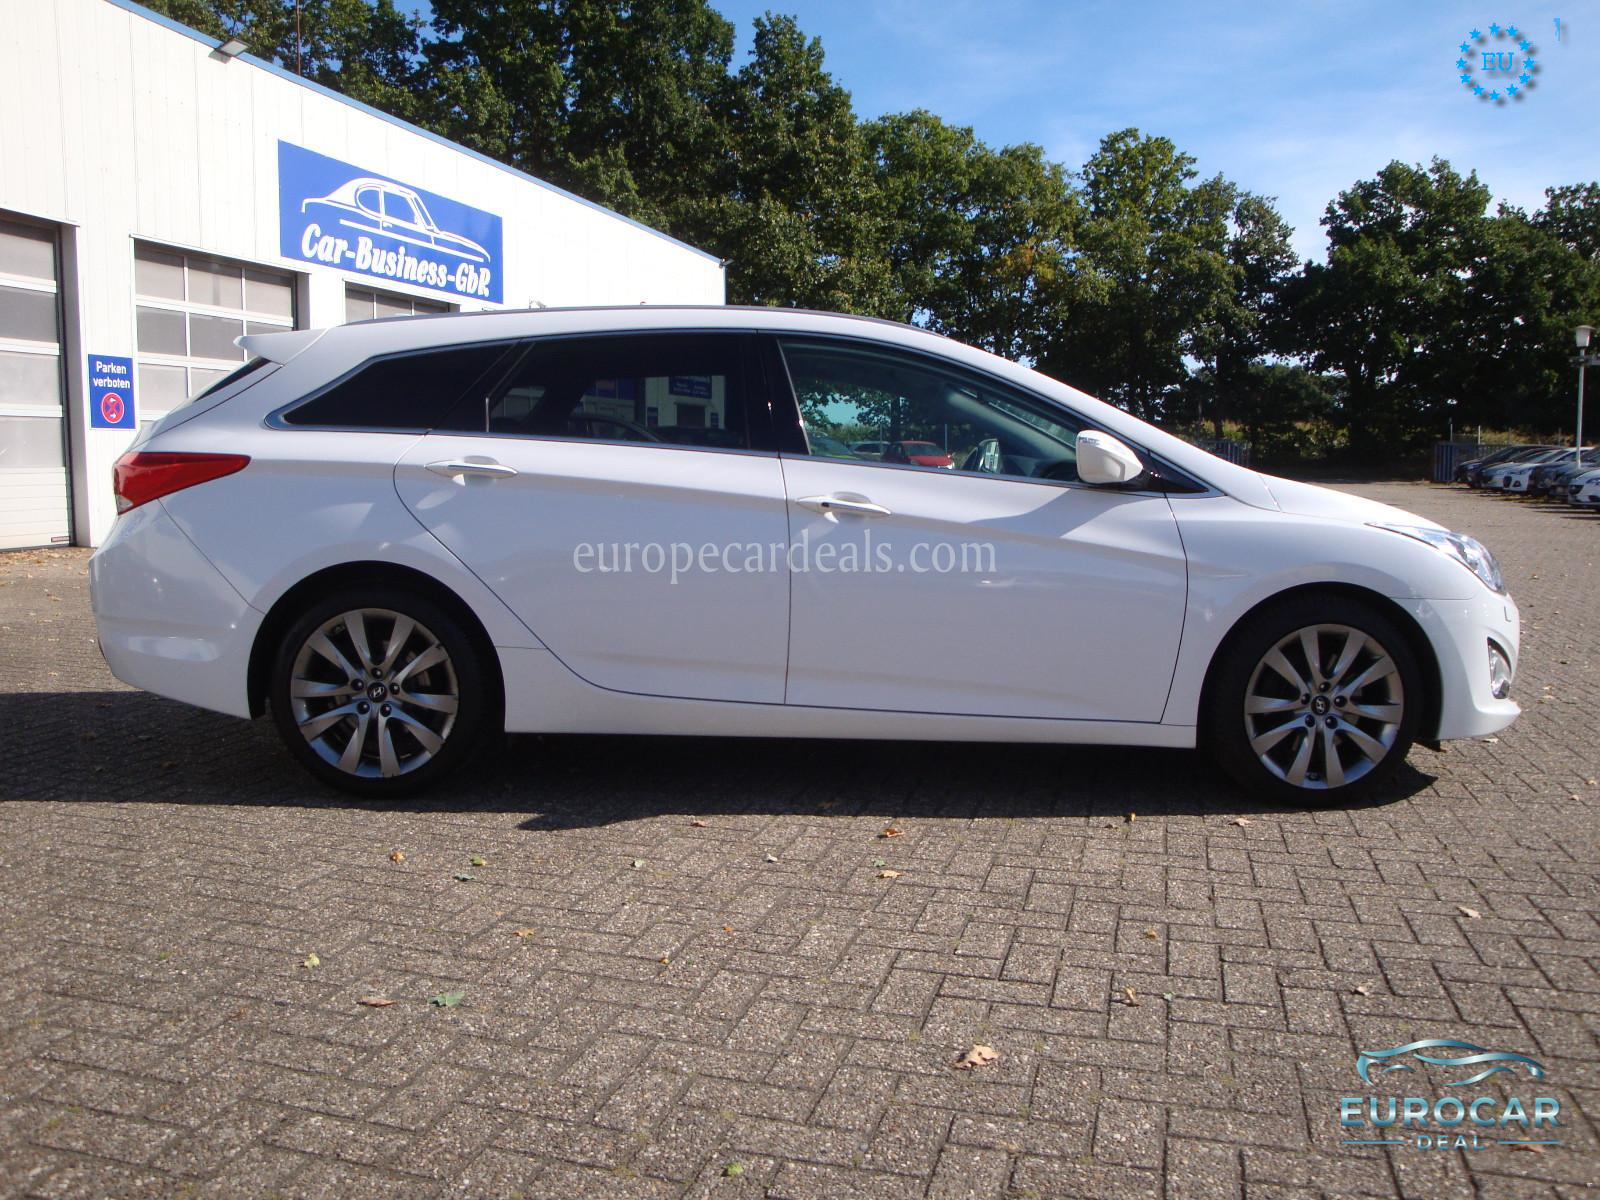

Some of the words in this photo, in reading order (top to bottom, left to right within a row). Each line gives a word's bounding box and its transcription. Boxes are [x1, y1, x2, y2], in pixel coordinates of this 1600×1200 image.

[301, 223, 491, 298] Car-Business-GbR
[96, 361, 127, 374] Parken
[93, 376, 131, 389] verboten
